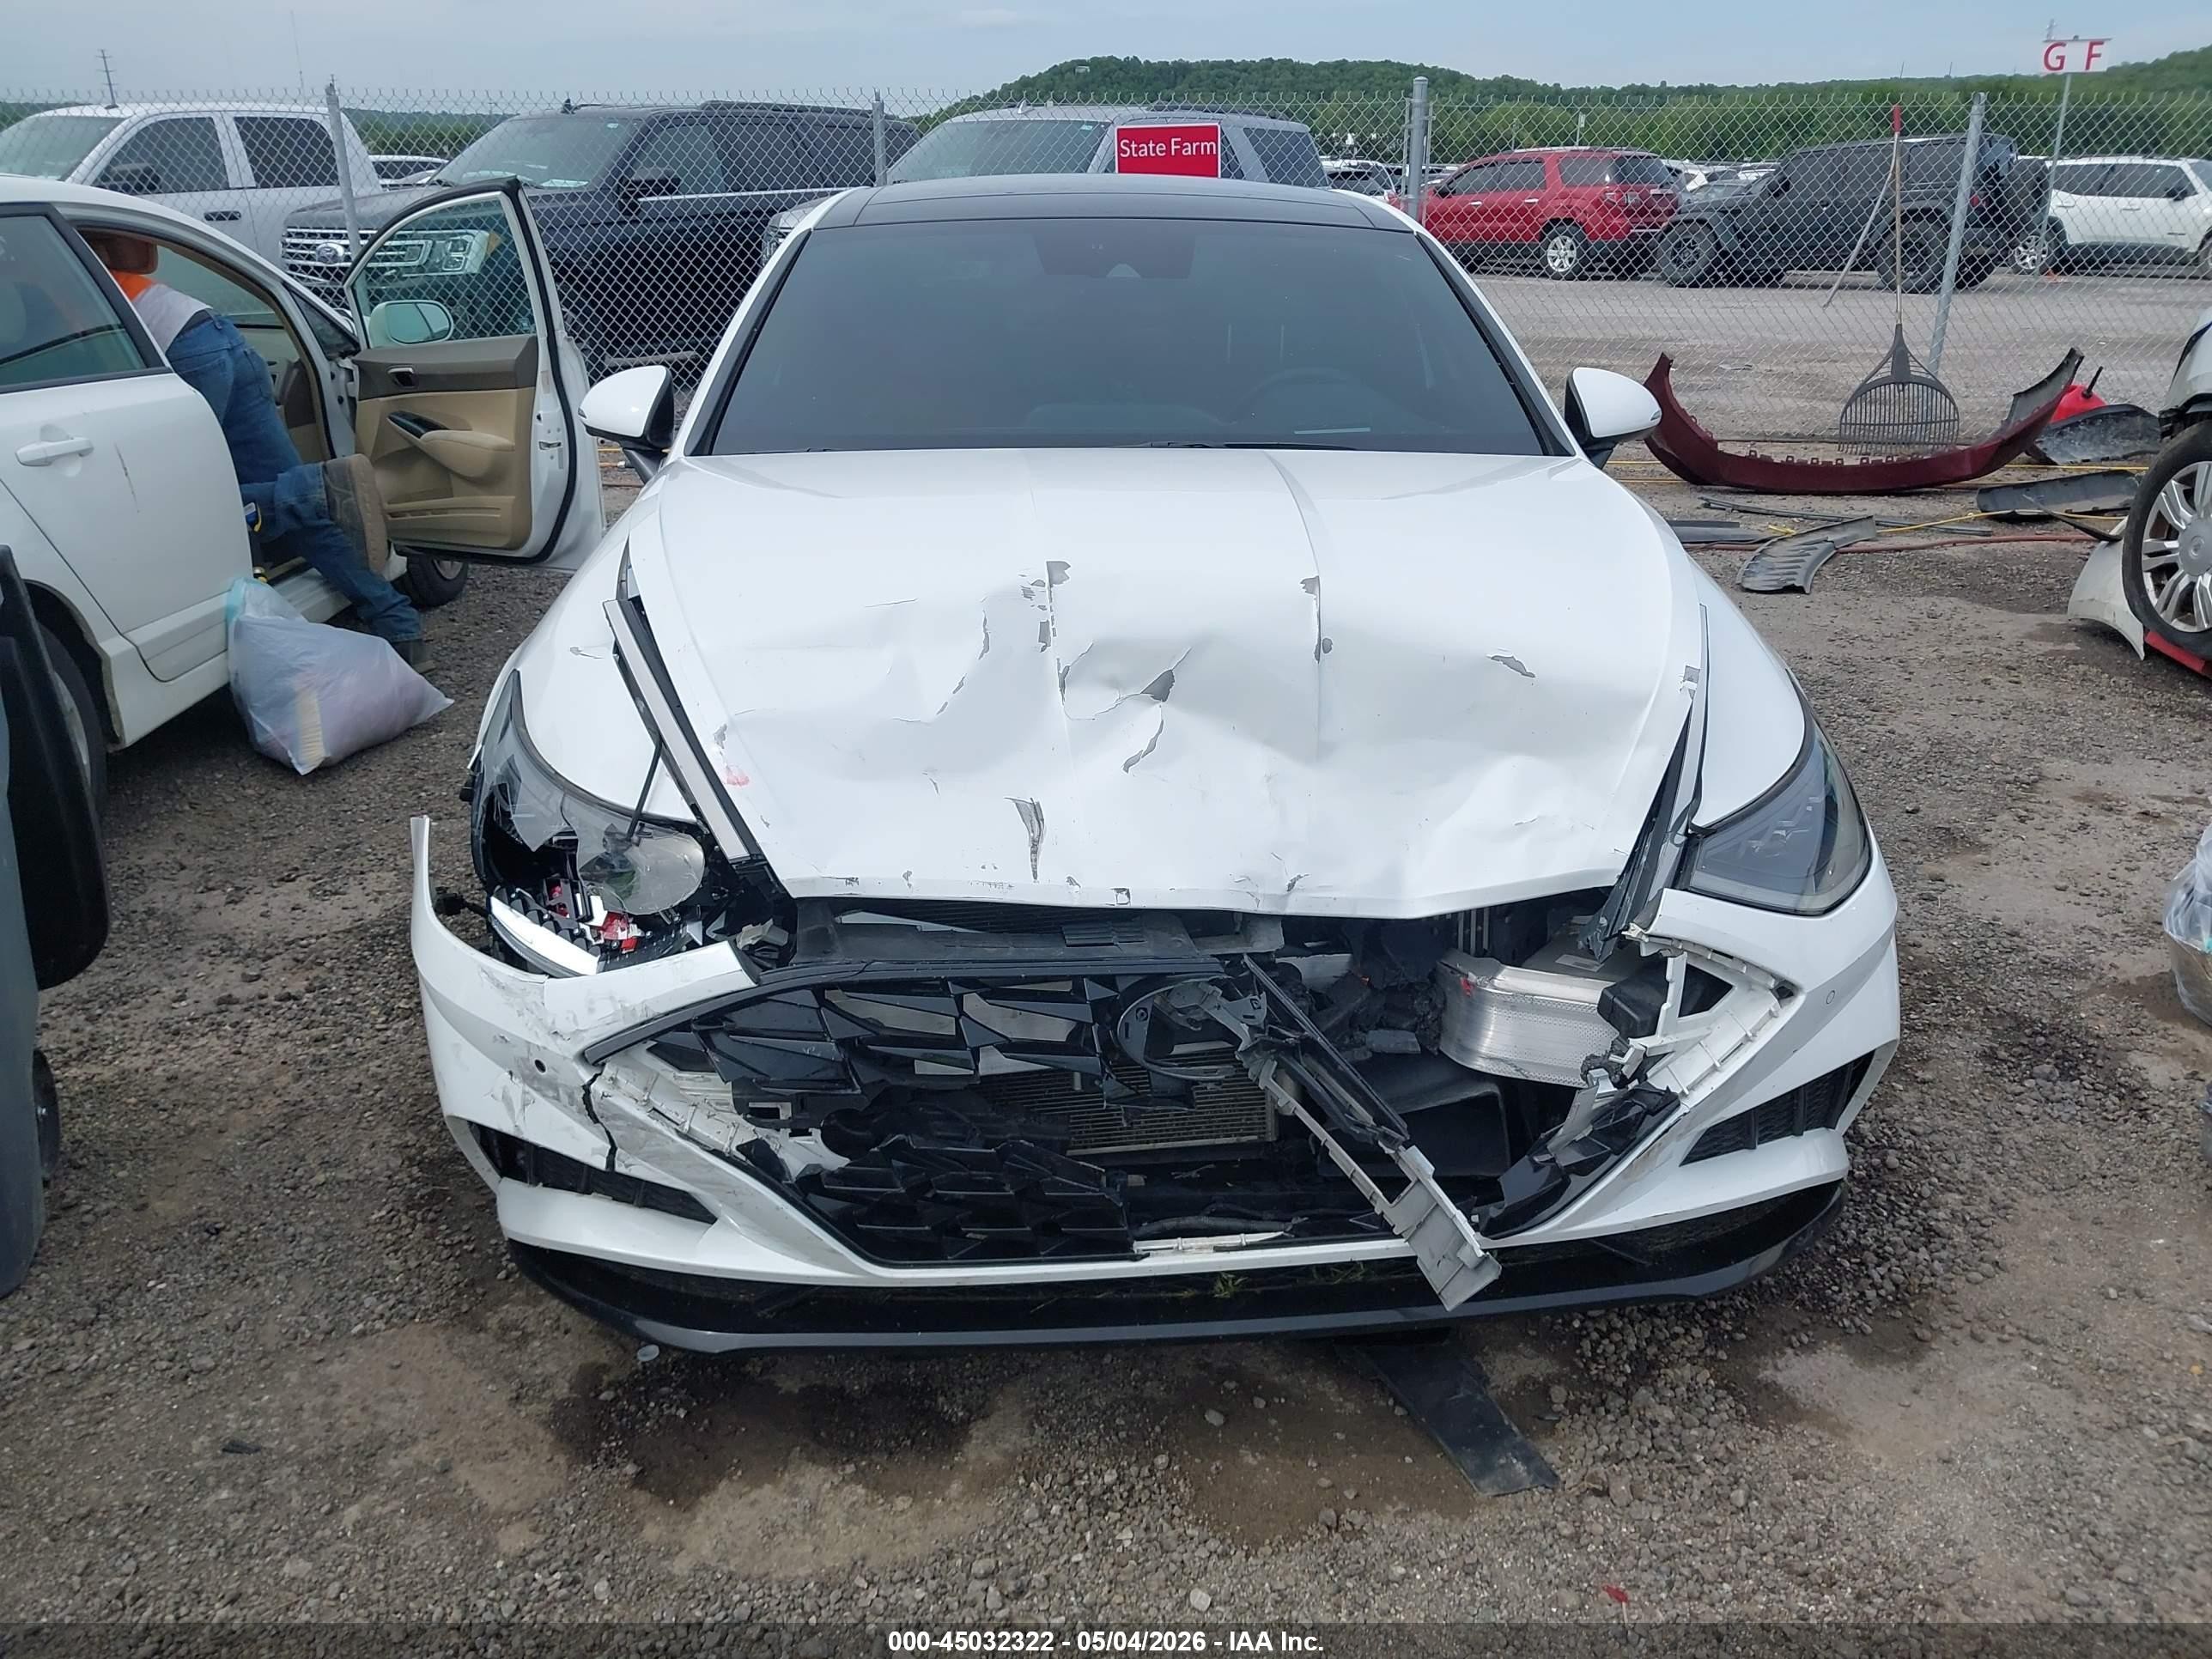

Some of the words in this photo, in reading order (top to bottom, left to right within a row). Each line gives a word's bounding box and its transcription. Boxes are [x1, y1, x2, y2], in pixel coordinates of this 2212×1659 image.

[2044, 41, 2067, 71] G
[2085, 40, 2105, 70] F
[1120, 139, 1166, 157] State
[1170, 137, 1217, 156] Farm
